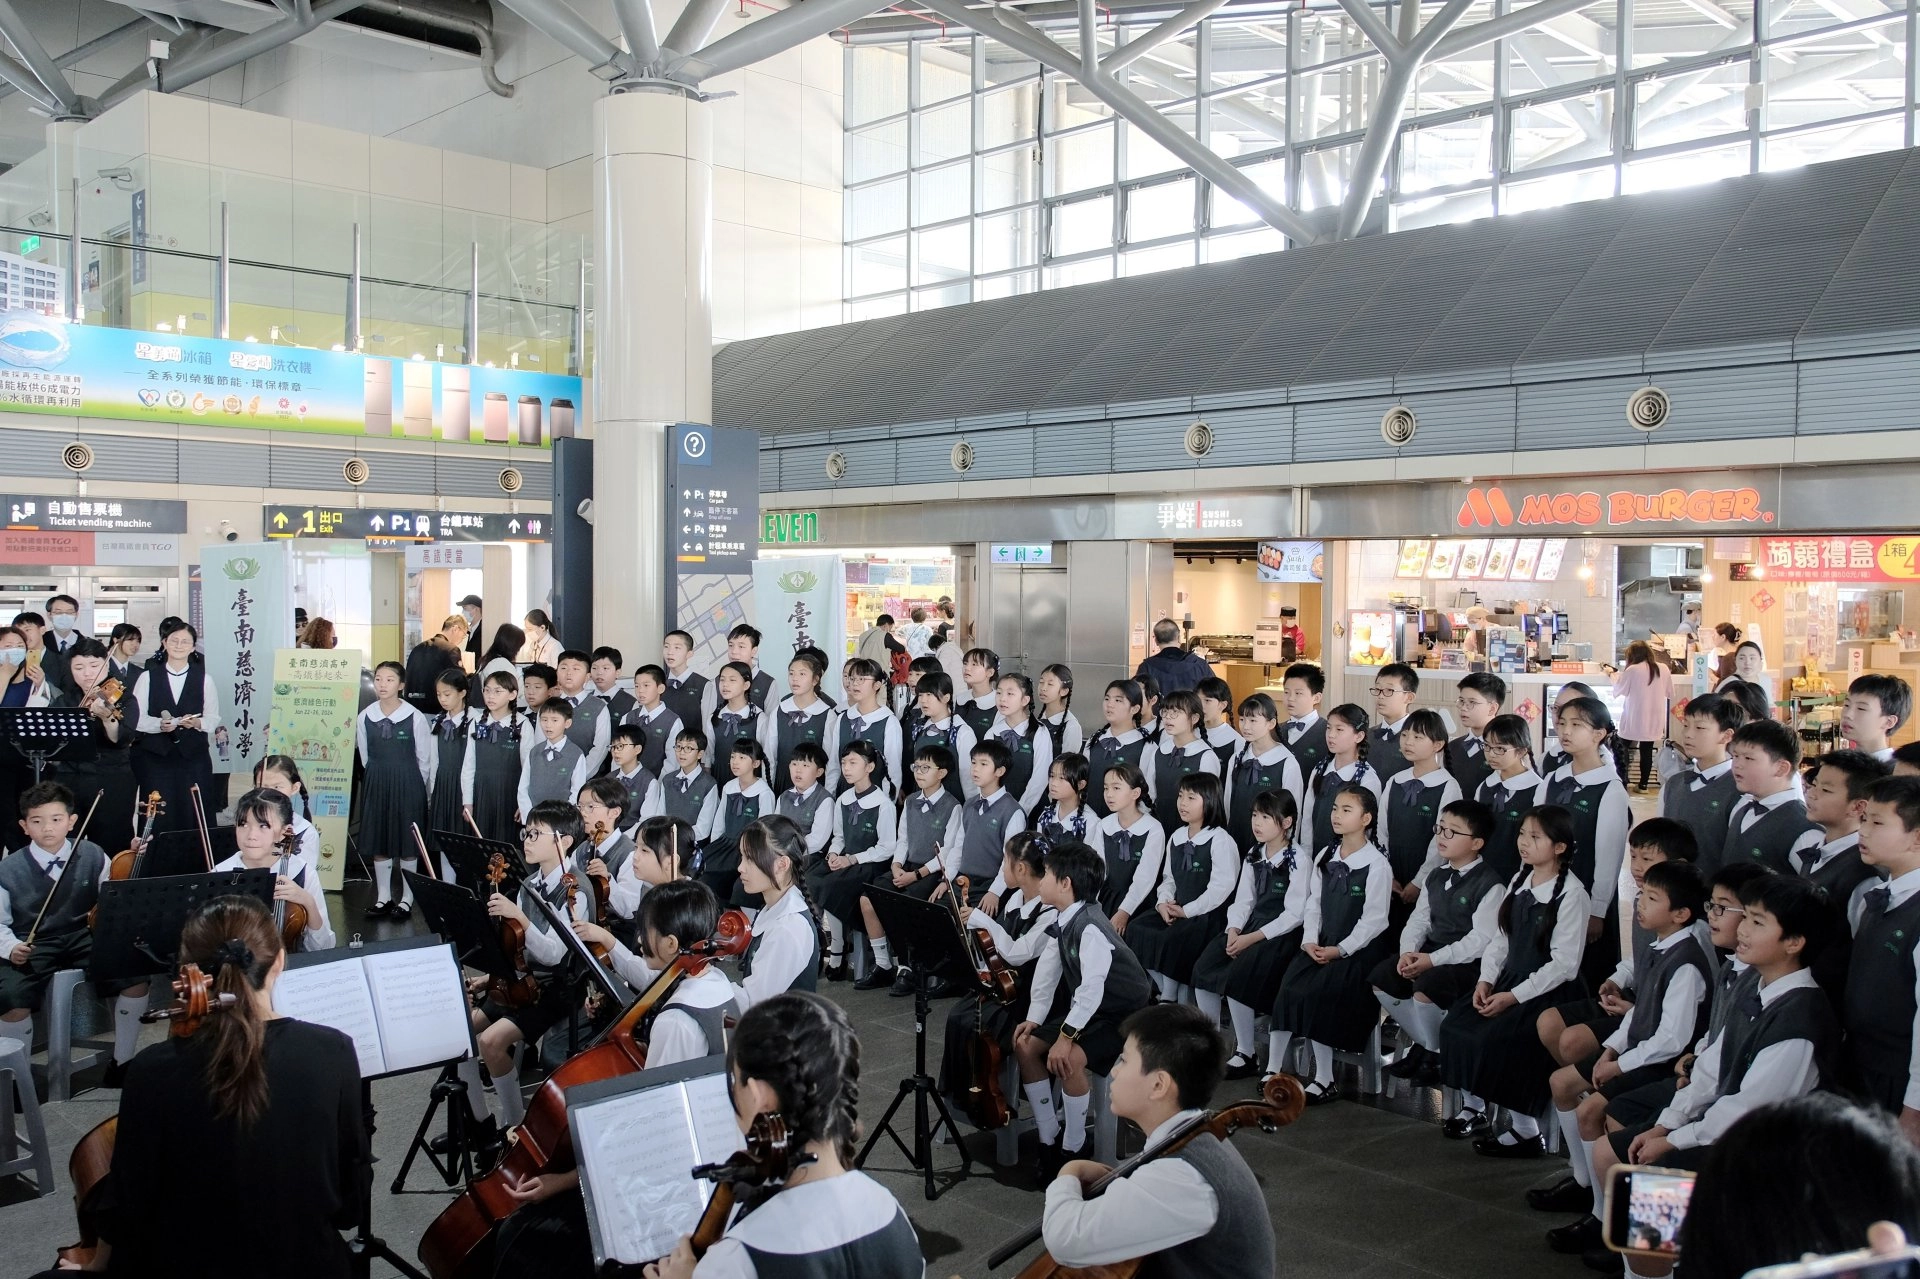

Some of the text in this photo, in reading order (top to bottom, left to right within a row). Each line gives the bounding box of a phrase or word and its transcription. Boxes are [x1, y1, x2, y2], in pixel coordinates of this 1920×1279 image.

[694, 489, 728, 500] P1 停車場
[48, 501, 123, 517] 自動售票機
[1517, 491, 1601, 526] MOS
[1607, 487, 1762, 525] BURGER
[1156, 501, 1195, 529] 爭鮮
[1202, 510, 1230, 518] SUSHI
[49, 516, 152, 529] Ticket vending machine
[302, 510, 343, 533] 1 出口
[391, 514, 411, 531] P1
[440, 514, 484, 529] 台鐵車站
[1202, 519, 1243, 529] EXPRESS
[319, 524, 334, 533] Exit
[440, 528, 454, 537] TRA
[694, 524, 728, 535] P4 停車場
[51, 537, 72, 545] TGO
[151, 543, 172, 551] TGO
[1286, 554, 1305, 563] Sushi
[1767, 540, 1875, 569] 蒟蒻禮盒
[288, 658, 348, 669] 臺南慈濟高中
[231, 588, 256, 759] 臺南慈濟小學
[1697, 667, 1703, 680] 入口
